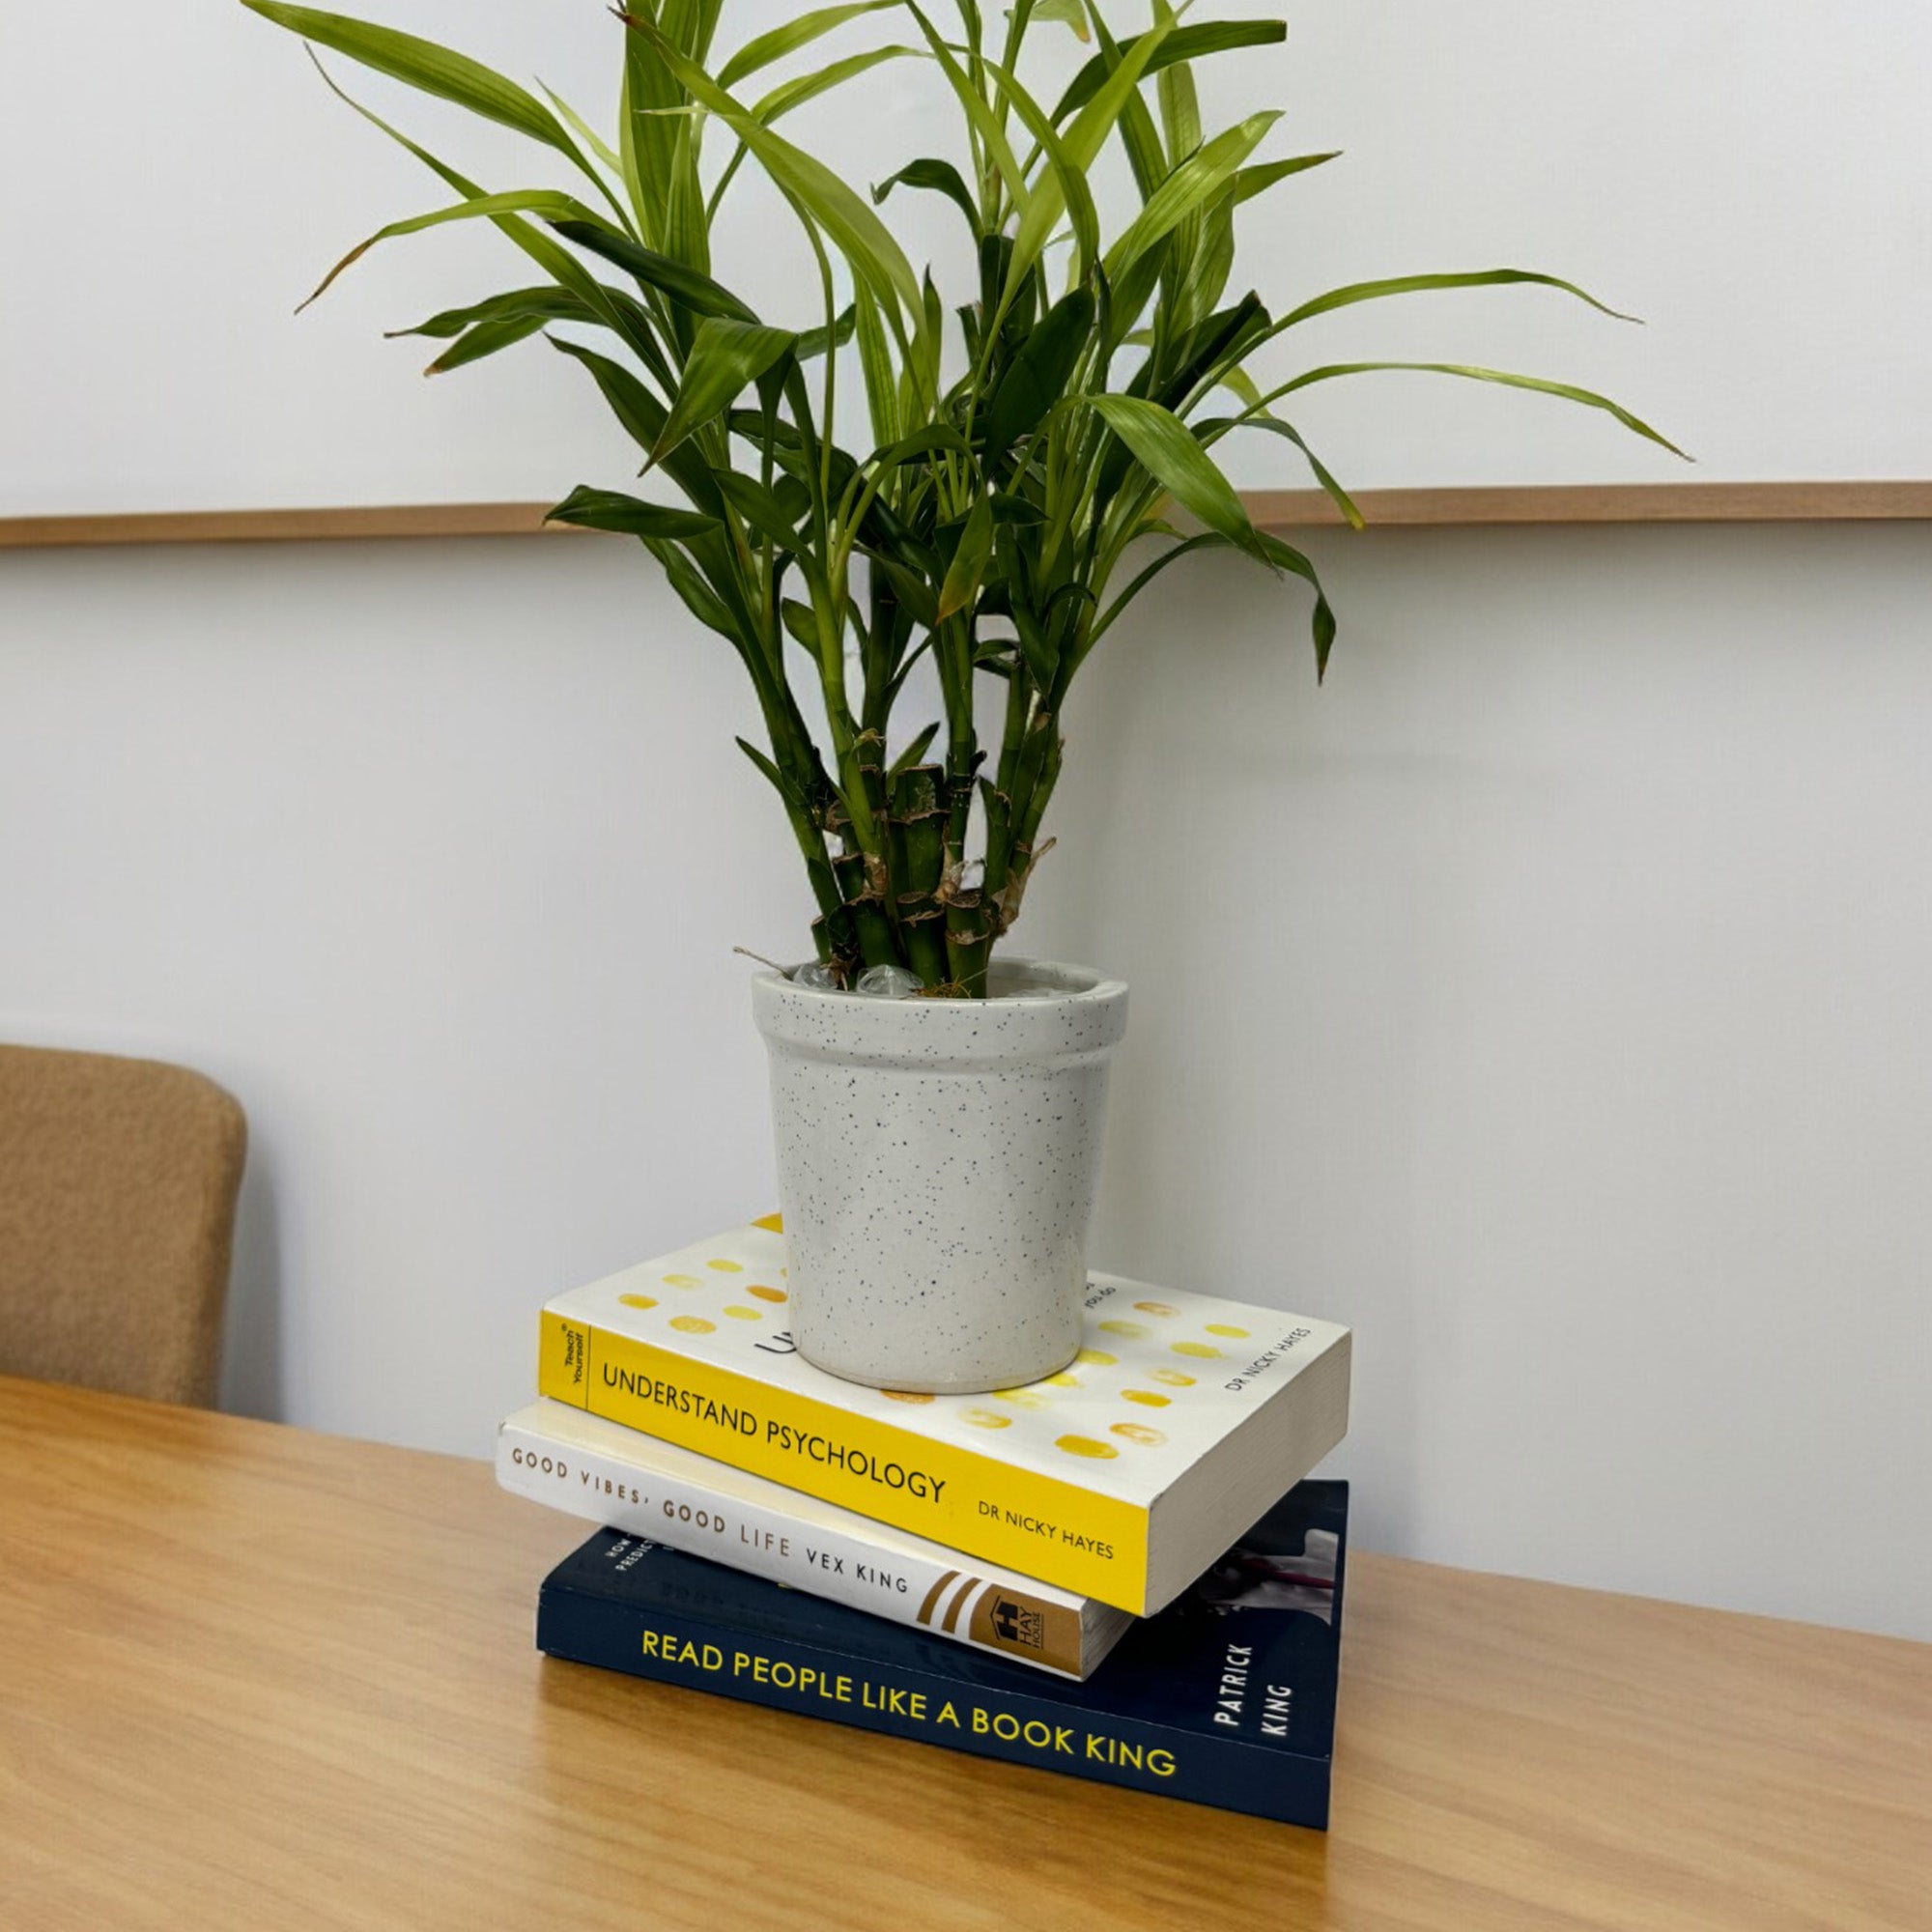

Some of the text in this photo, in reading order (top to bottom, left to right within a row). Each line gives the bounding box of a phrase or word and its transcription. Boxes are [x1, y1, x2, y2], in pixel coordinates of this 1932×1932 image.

[565, 1329, 575, 1367] Teach
[574, 1332, 583, 1384] Yourself
[1224, 1327, 1311, 1391] DR NICKY HAYES
[603, 1362, 946, 1503] UNDERSTAND PSYCHOLOGY
[512, 1448, 567, 1478] GOOD
[663, 1499, 725, 1533] GOOD
[741, 1524, 790, 1556] LIFE
[807, 1548, 844, 1575] VEX
[856, 1564, 908, 1593] KING
[605, 1538, 632, 1558] HOW
[979, 1500, 1114, 1560] DR NICKY HAYES
[1019, 1606, 1033, 1645] HAY
[1032, 1611, 1041, 1649] HOUSE
[642, 1630, 1176, 1776] READ PEOPLE LIKE A BOOK KING
[1213, 1643, 1253, 1726] PATRICK
[1260, 1685, 1293, 1736] KING
